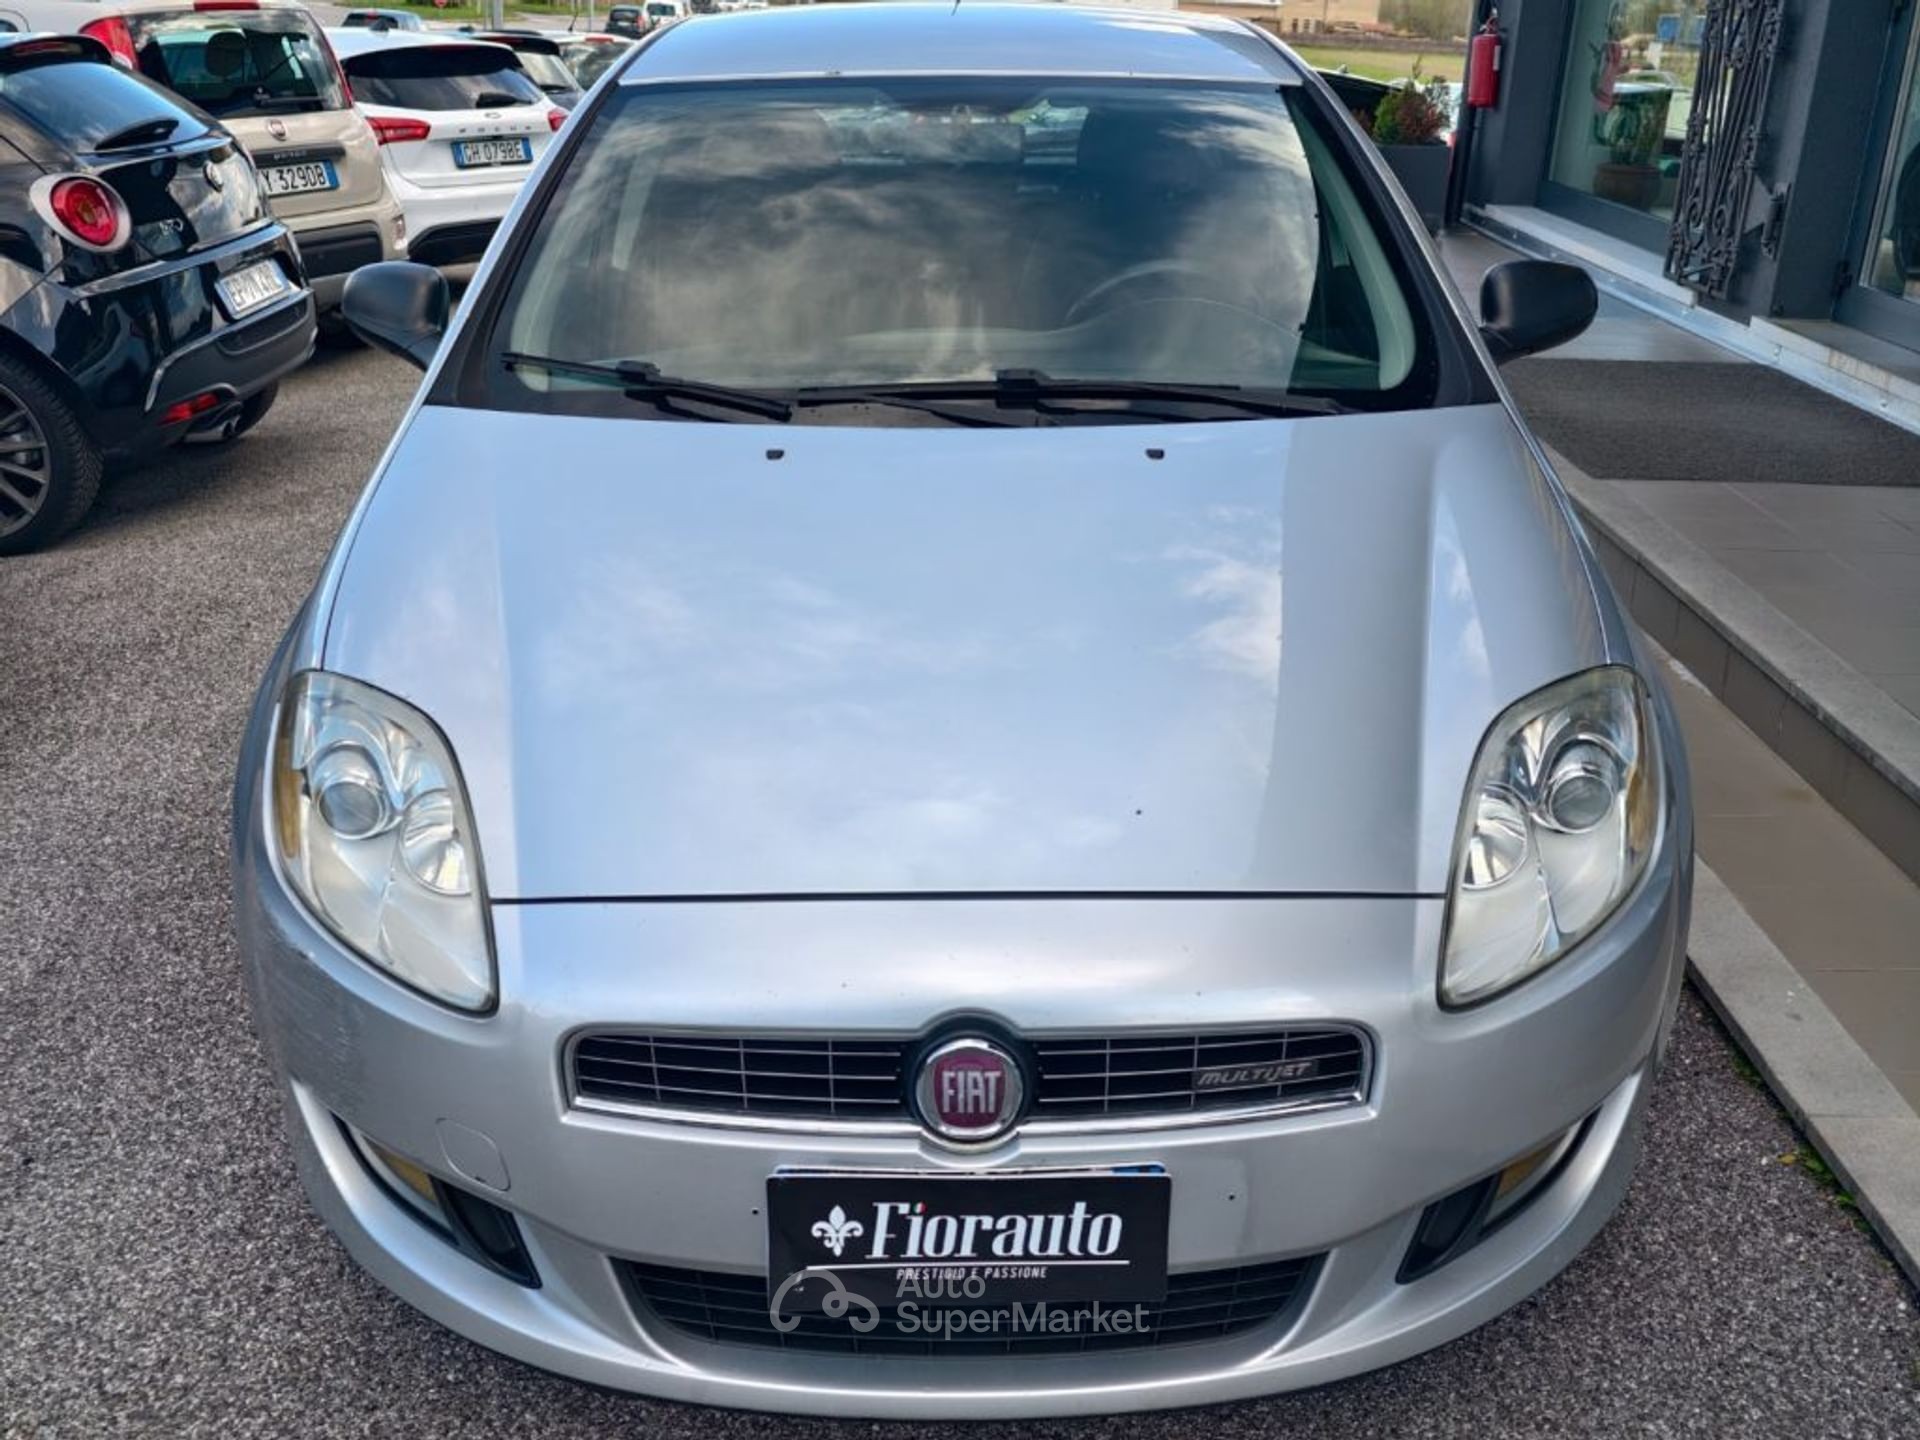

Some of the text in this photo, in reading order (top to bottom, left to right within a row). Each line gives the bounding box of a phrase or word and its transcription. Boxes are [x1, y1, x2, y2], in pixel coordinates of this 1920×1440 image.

[1197, 1061, 1313, 1086] MULTIJET
[942, 1070, 1002, 1113] FIAT
[864, 1200, 1122, 1258] Fiorauto
[896, 1265, 1049, 1281] PRESTIGIO E PASSIONE
